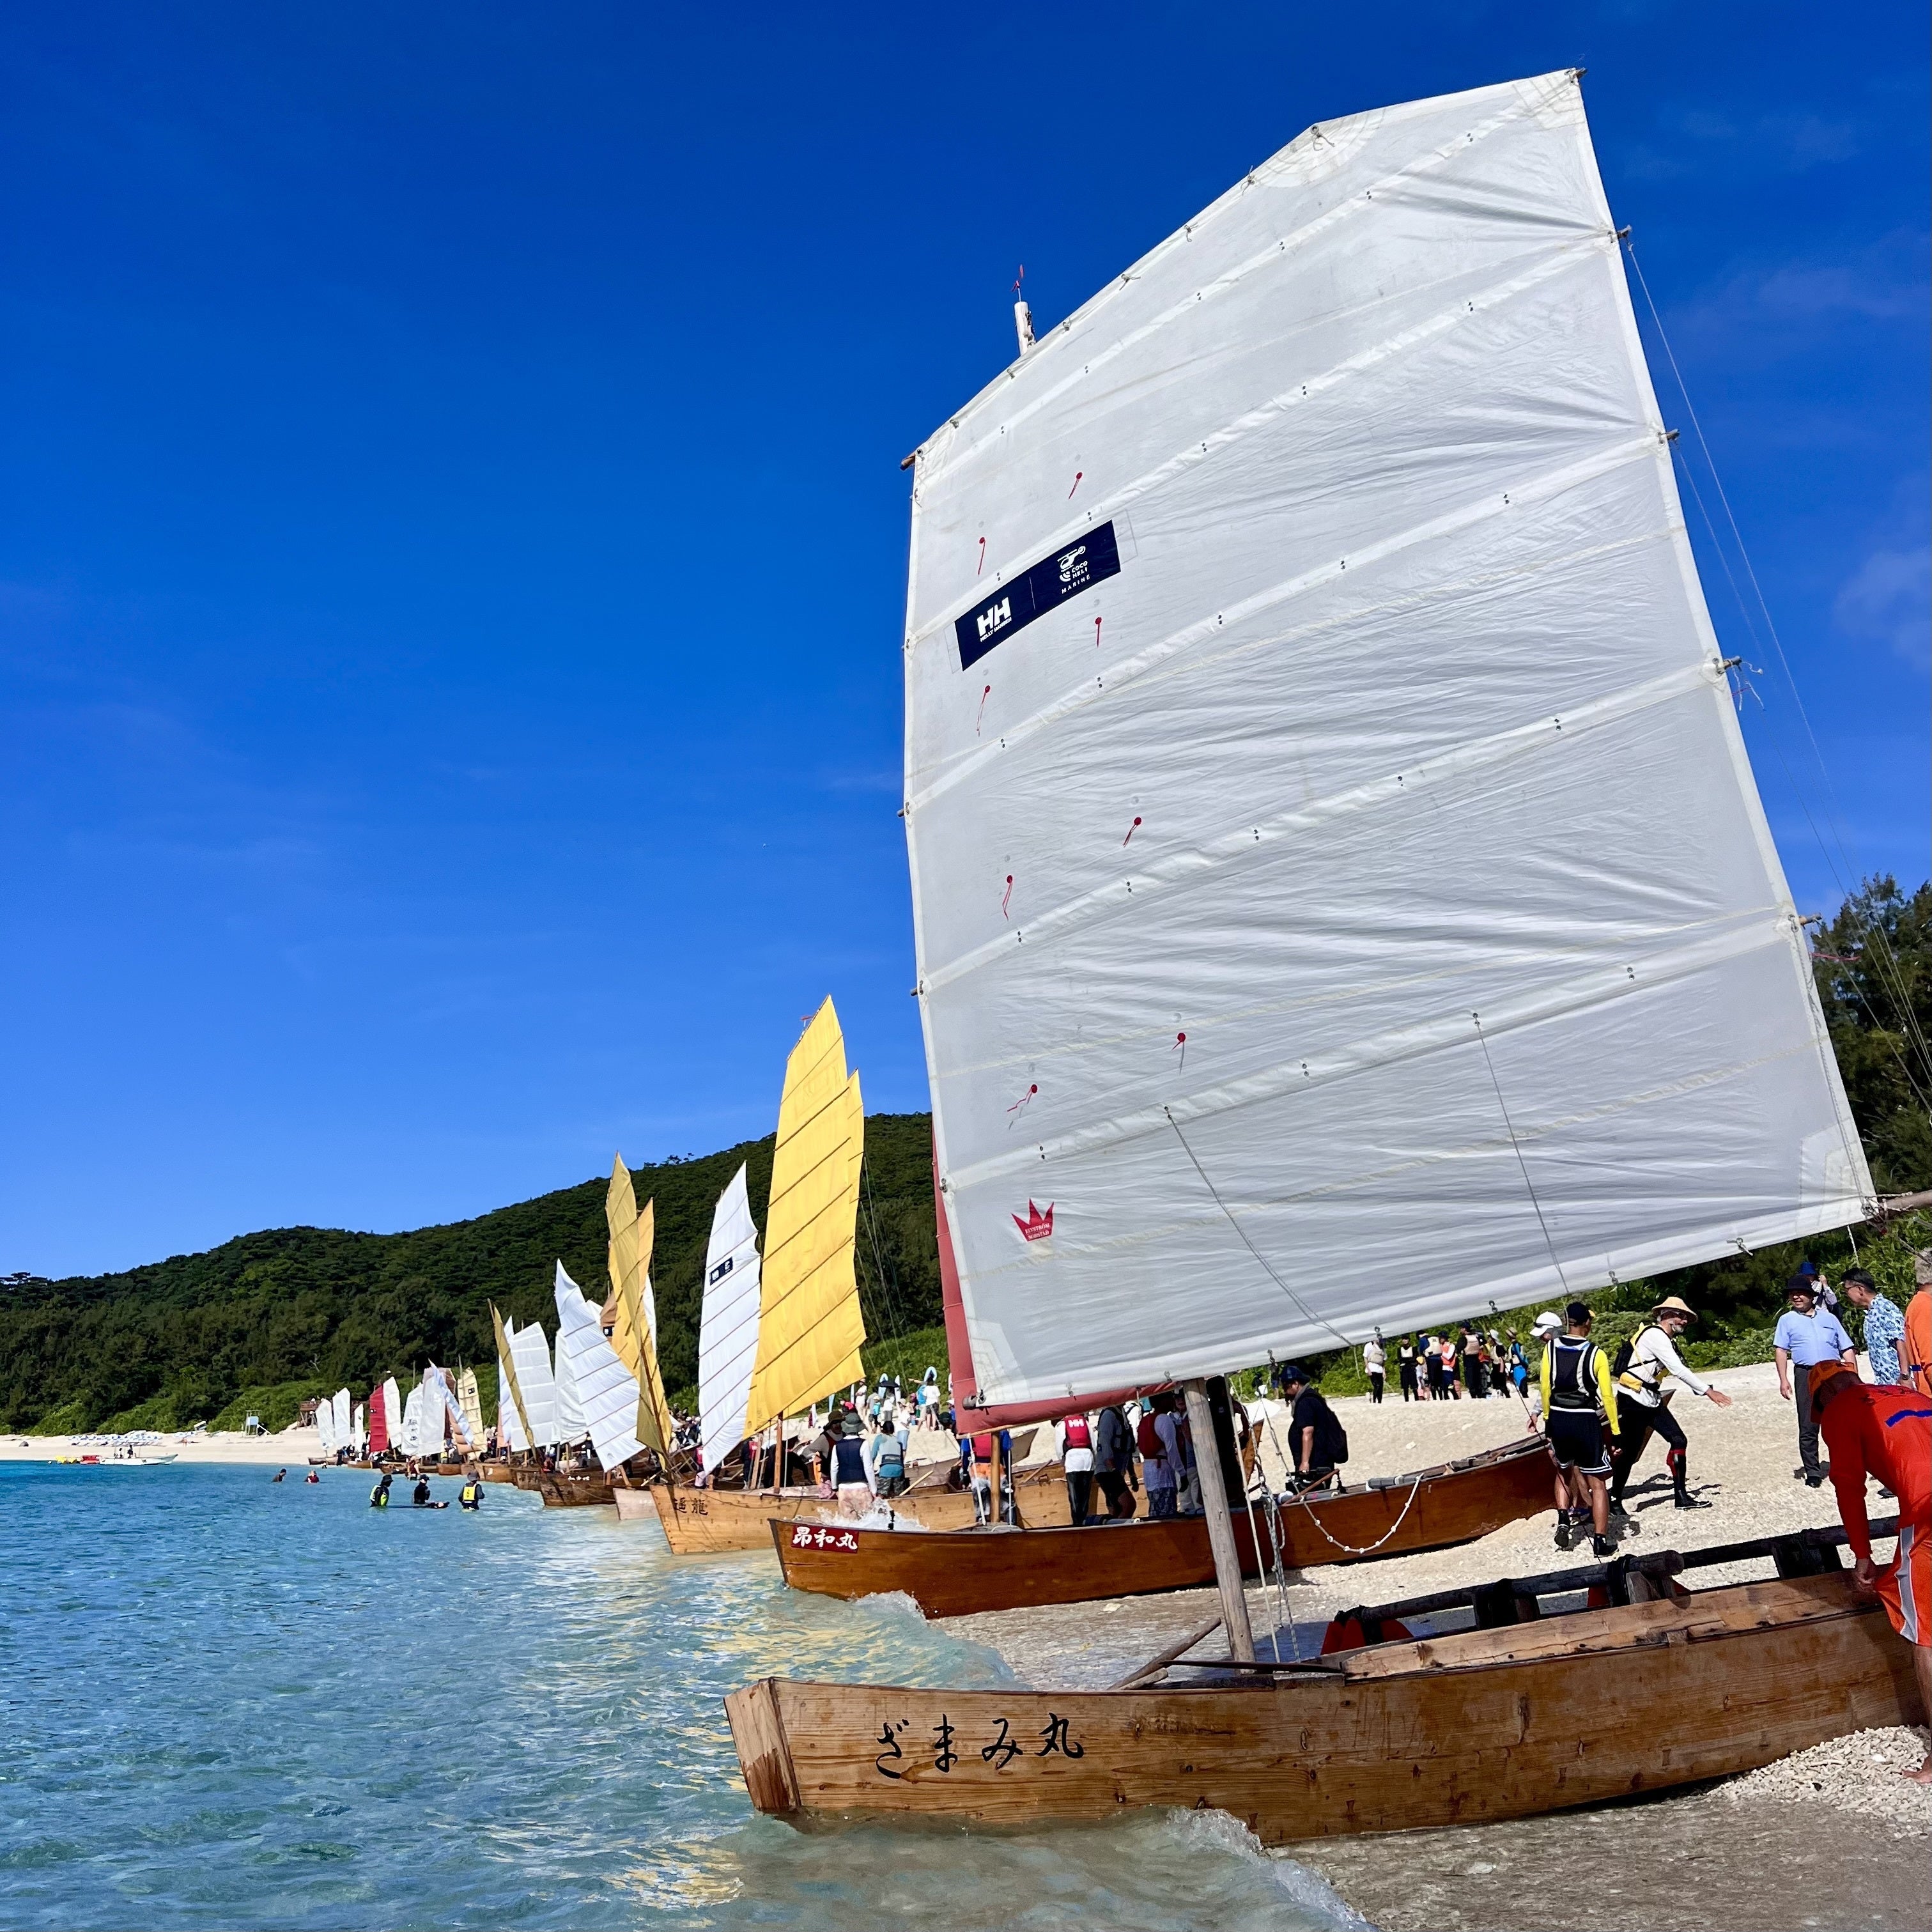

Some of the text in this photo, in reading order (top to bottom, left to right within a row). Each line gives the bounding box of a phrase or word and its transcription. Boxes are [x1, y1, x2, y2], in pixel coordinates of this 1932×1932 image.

[1072, 561, 1088, 573] COCO
[1072, 567, 1088, 578] HELI
[1062, 574, 1090, 594] MARINE
[977, 597, 1011, 637] HH
[980, 617, 1012, 642] HELLY HANSEN
[1068, 1419, 1085, 1428] HH
[792, 1526, 858, 1550] 昂和丸
[876, 1713, 1085, 1779] ざまみ丸
